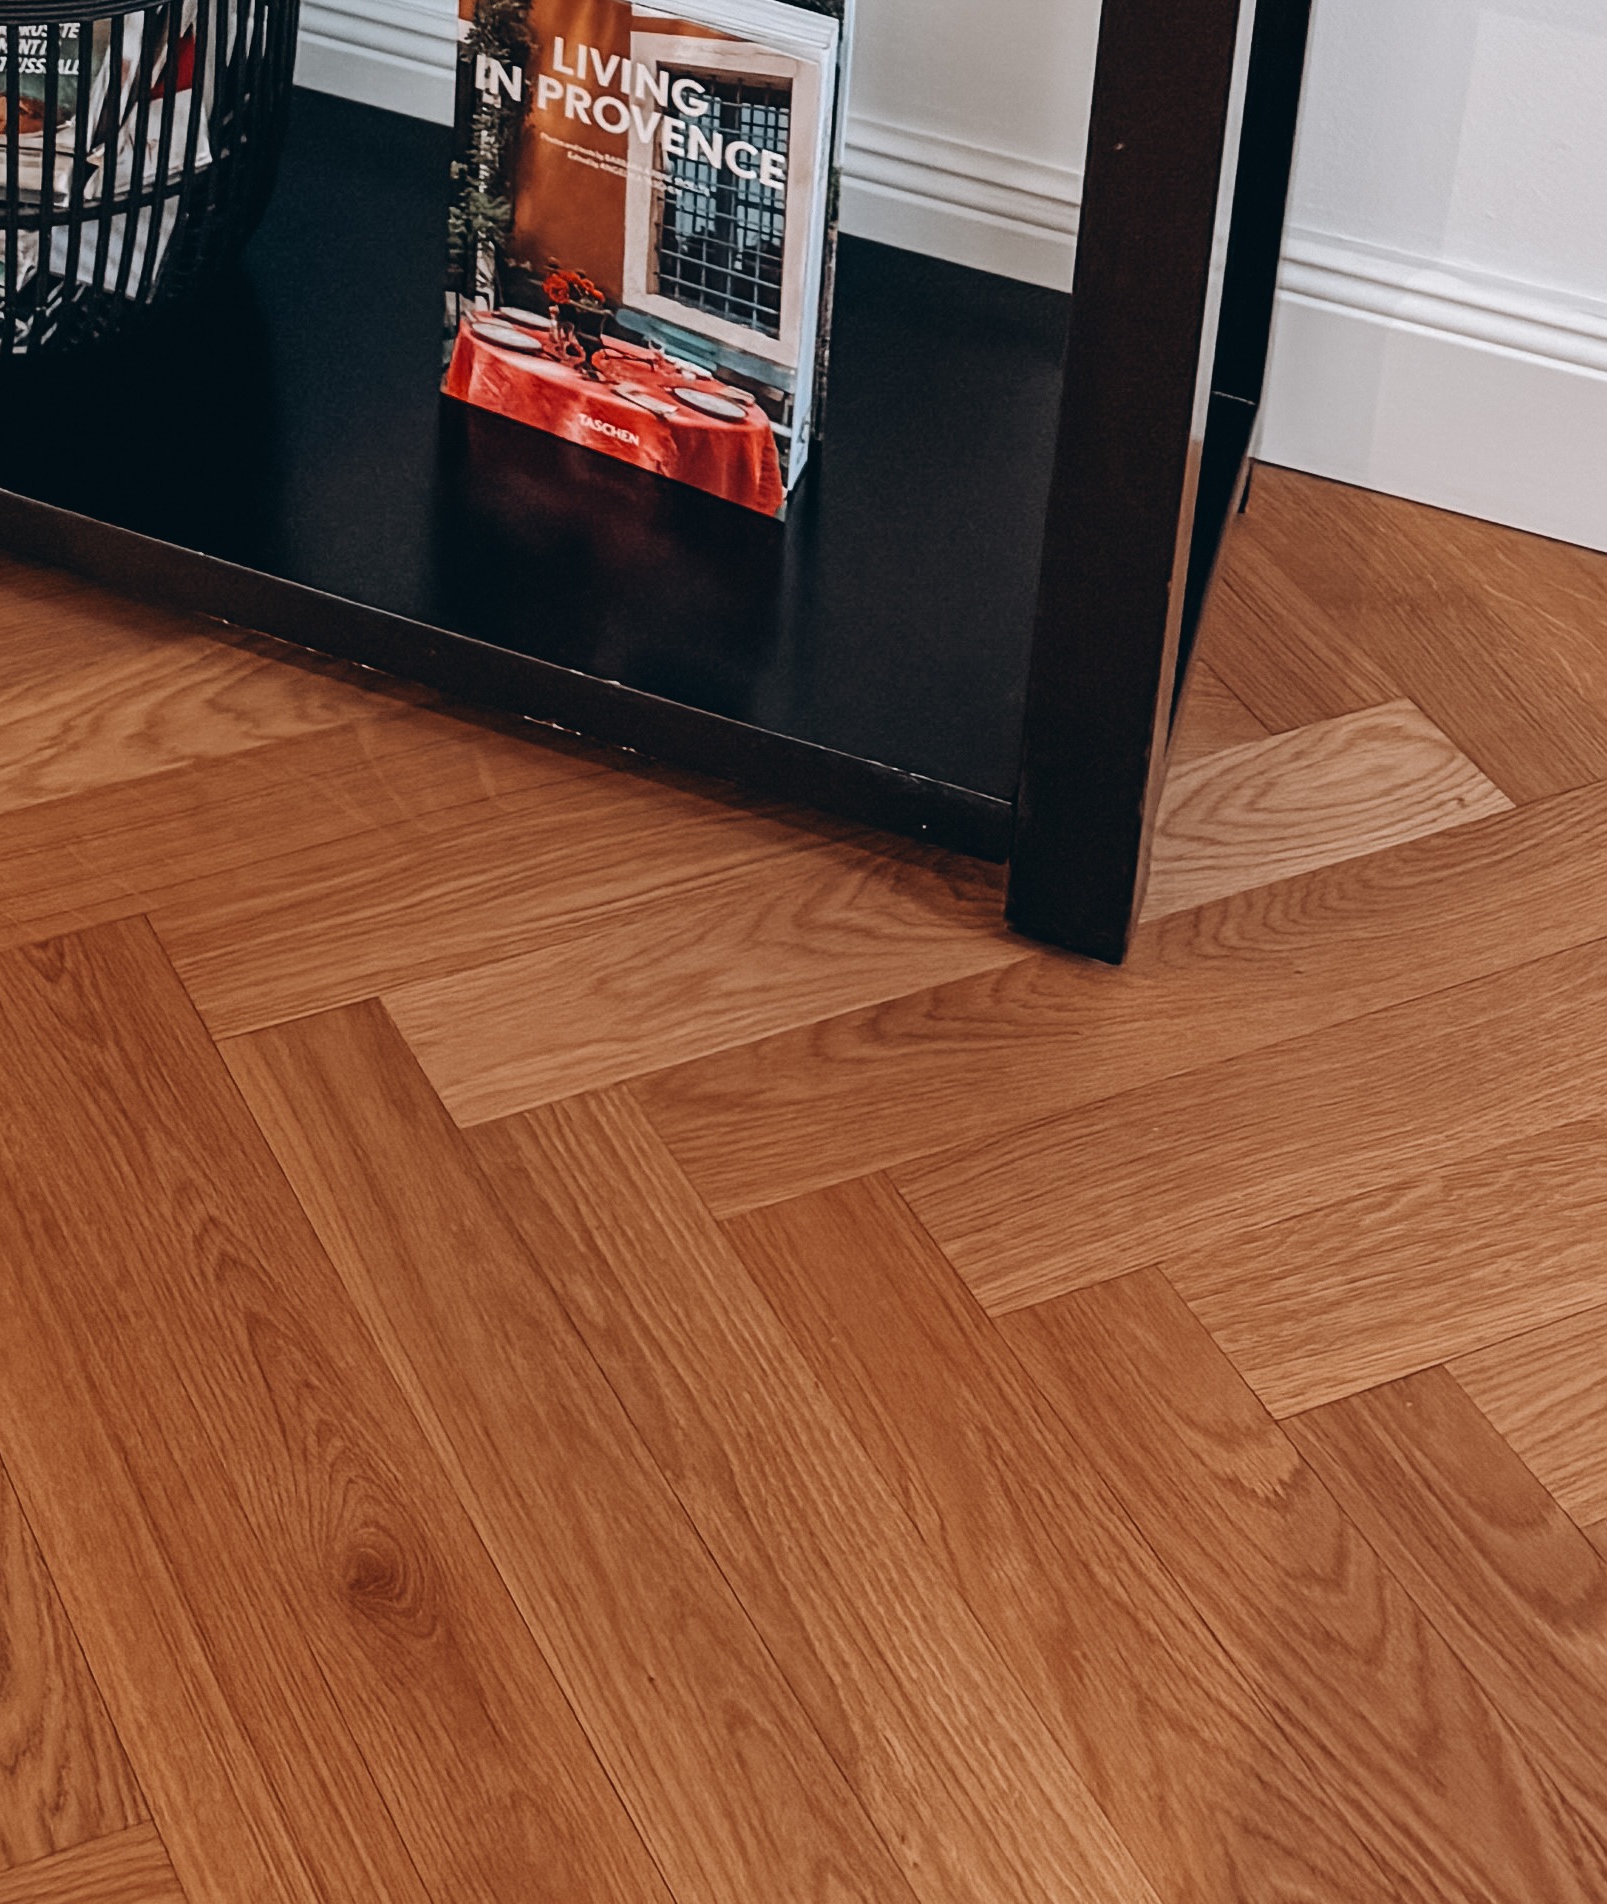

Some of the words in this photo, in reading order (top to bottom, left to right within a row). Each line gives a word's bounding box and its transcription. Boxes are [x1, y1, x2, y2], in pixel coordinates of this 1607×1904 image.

[552, 36, 709, 118] LIVING
[475, 53, 522, 102] IN
[537, 73, 787, 191] PROVENCE
[577, 413, 640, 447] TASCHEN
